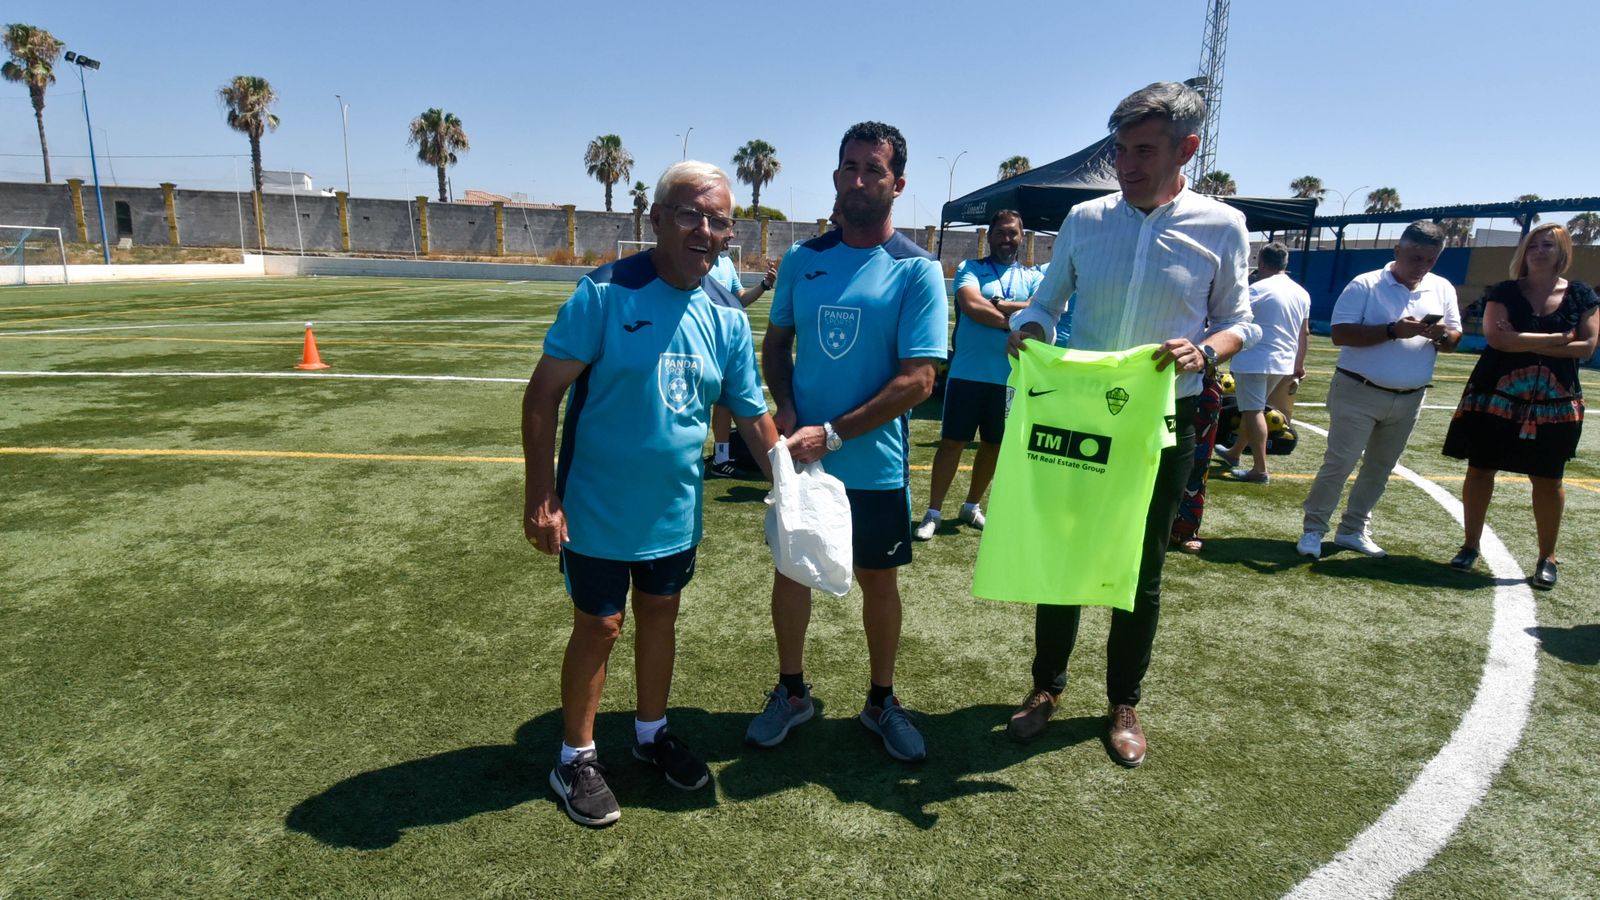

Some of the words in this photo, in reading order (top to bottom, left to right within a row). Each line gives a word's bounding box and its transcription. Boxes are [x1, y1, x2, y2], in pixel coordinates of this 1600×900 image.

[824, 310, 855, 321] PANDA
[664, 358, 698, 370] PANDA
[664, 367, 697, 377] SPORTS
[1035, 431, 1063, 451] TM
[1027, 452, 1039, 460] TM
[1039, 455, 1056, 464] Real
[1056, 458, 1080, 470] Estate
[1081, 463, 1106, 475] Group
